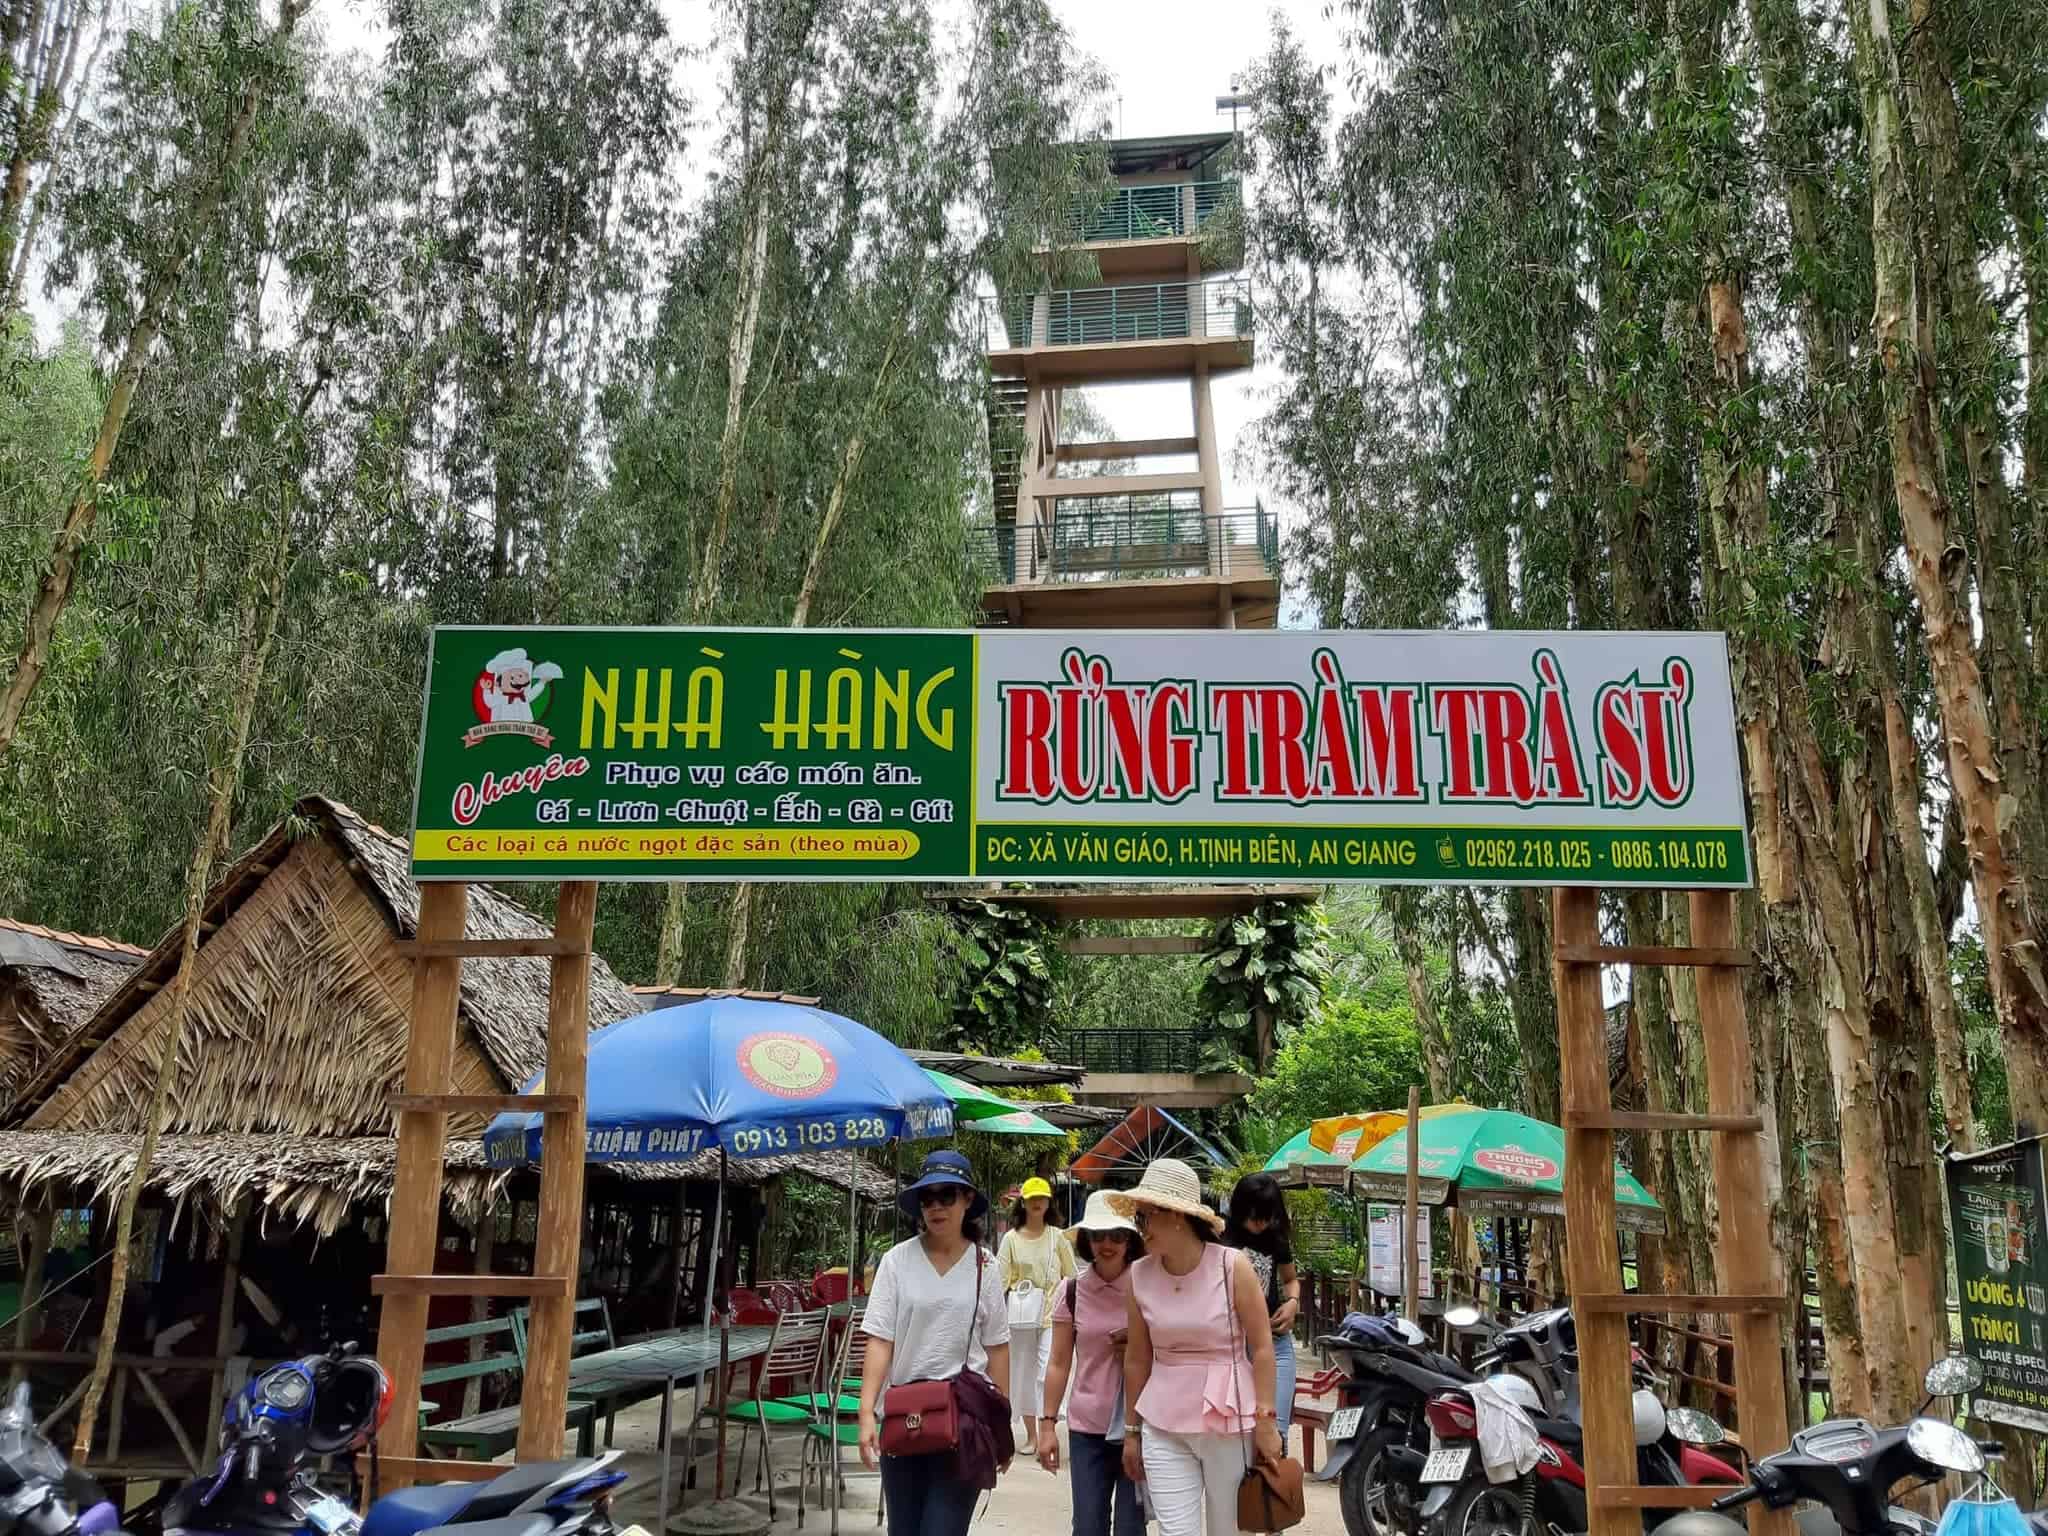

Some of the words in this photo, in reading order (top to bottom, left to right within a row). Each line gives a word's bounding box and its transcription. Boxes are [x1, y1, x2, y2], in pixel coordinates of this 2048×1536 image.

[579, 646, 724, 749] NHÀ
[760, 648, 955, 752] HÀNG
[1000, 650, 1197, 802] RỪNG
[1209, 651, 1424, 803] TRÀM
[1429, 652, 1589, 805] TRÀ
[1597, 660, 1689, 805] SƯ
[452, 753, 590, 825] Chuyên
[606, 762, 680, 788] Phục
[688, 765, 724, 788] vụ
[736, 761, 788, 785] các
[799, 762, 863, 785] món
[873, 762, 922, 785] ăn.
[537, 799, 569, 822] Cá
[598, 799, 658, 822] Lươn
[774, 792, 821, 822] Ếch
[848, 799, 882, 822] Gà
[910, 799, 952, 822] Cút
[447, 835, 488, 852] Các
[497, 836, 535, 855] loại
[544, 836, 568, 852] cá
[577, 836, 630, 852] nước
[639, 836, 687, 855] ngọt
[695, 834, 734, 855] đặc
[744, 832, 780, 851] sản
[790, 836, 844, 855] (theo
[853, 834, 909, 855] mùa)
[987, 837, 1022, 862] ĐC:
[1029, 832, 1057, 862] XÃ
[1063, 832, 1107, 862] VĂN
[1114, 832, 1173, 867] GIÁO,
[1180, 838, 1243, 868] H.TỊNH
[1249, 833, 1302, 868] BIÊN,
[1309, 840, 1338, 864] AN
[1344, 840, 1417, 865] GIANG
[1466, 839, 1592, 868] 02962.218.025
[1611, 840, 1728, 870] 0886.104.078
[734, 1126, 788, 1152] 0913
[797, 1122, 836, 1145] 103
[845, 1118, 886, 1140] 828
[1966, 1274, 2014, 1307] UỐNG
[2016, 1285, 2026, 1308] 4
